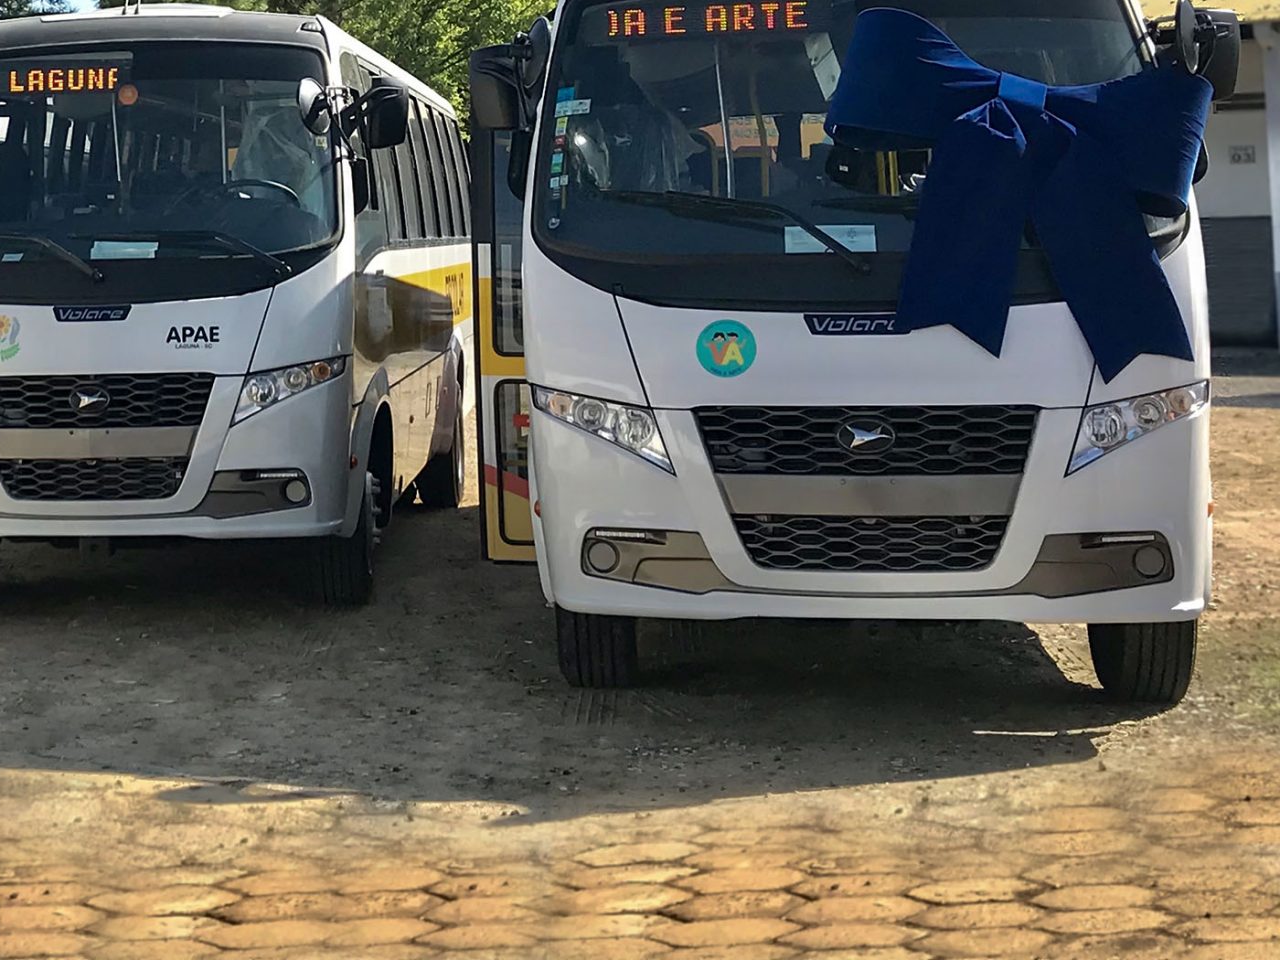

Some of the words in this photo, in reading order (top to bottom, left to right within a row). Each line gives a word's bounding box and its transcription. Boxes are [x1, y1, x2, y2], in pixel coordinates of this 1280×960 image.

[664, 7, 686, 33] E
[705, 1, 808, 32] ARTE
[59, 309, 124, 320] Volare
[166, 326, 220, 343] APAE
